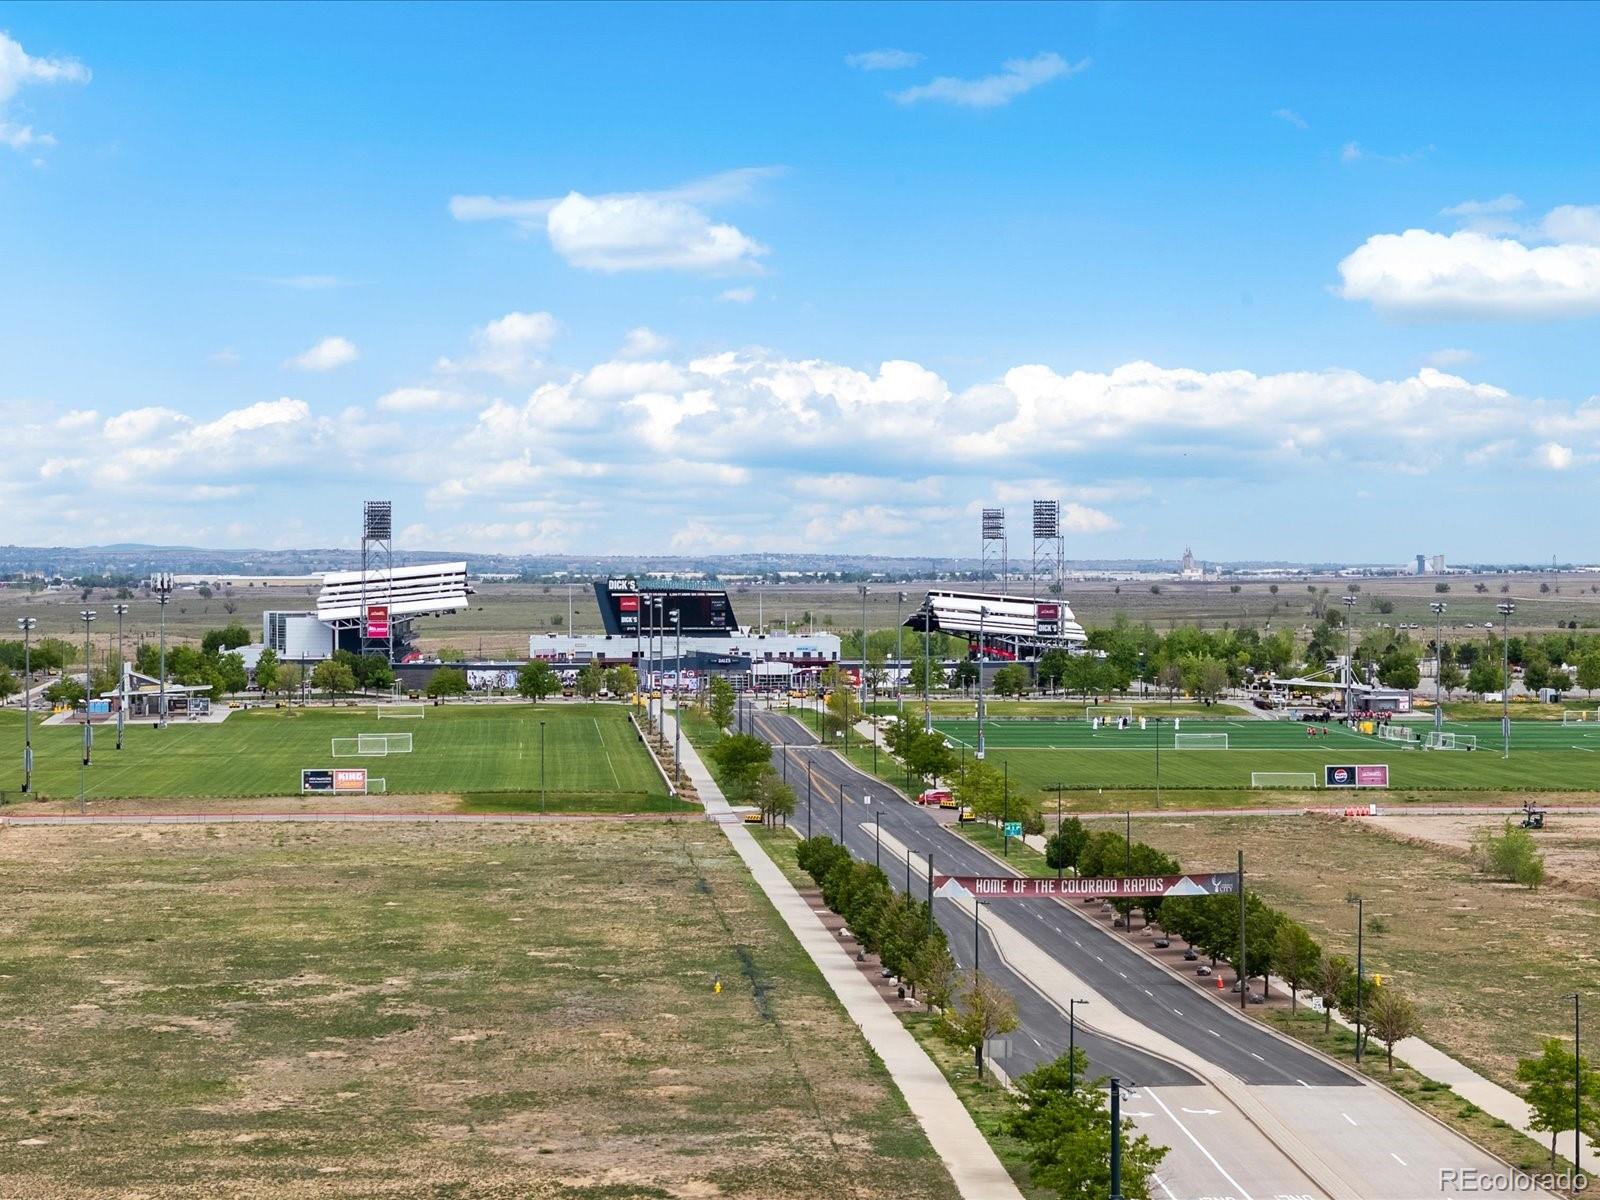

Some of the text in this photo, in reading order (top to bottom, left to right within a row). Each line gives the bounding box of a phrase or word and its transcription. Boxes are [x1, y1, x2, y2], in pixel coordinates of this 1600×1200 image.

[608, 580, 636, 590] DICK'S
[975, 878, 1163, 893] HOME OF THE COLORADO RAPIDS
